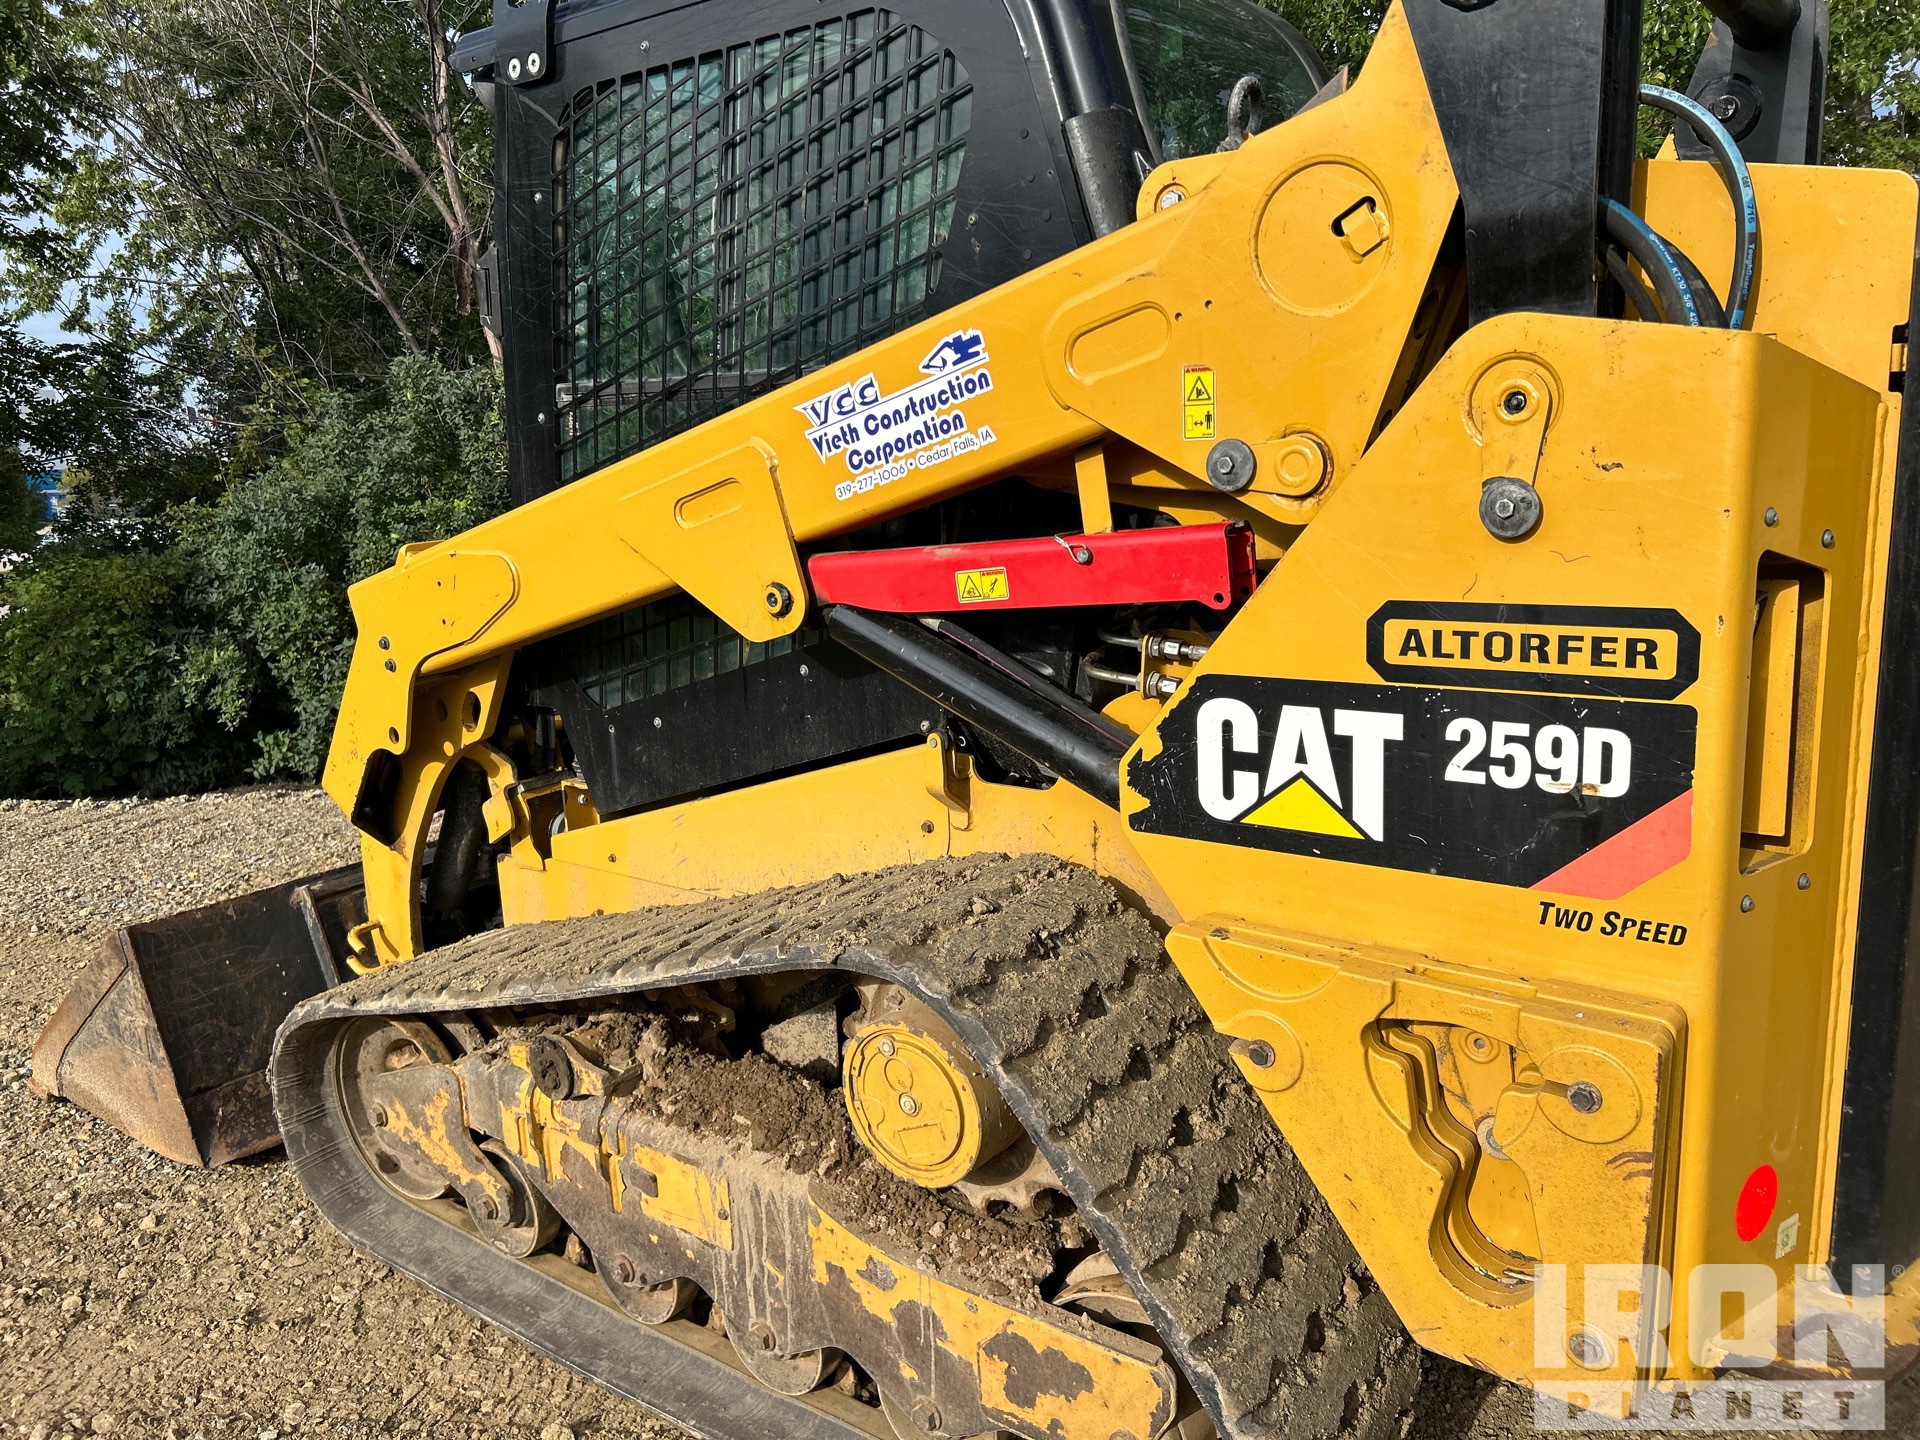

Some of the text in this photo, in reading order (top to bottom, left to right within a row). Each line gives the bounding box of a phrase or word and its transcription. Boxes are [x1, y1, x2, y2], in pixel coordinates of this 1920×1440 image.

[1747, 204, 1756, 224] 716
[1671, 267, 1687, 290] KT-10
[801, 376, 880, 427] VCC
[812, 372, 991, 455] Vieth Construction
[837, 430, 993, 498] 319-277-1006 Cedar Falls, IA
[848, 413, 965, 471] Corporation
[1398, 628, 1659, 671] ALTORFER
[1196, 697, 1632, 842] CAT 259D
